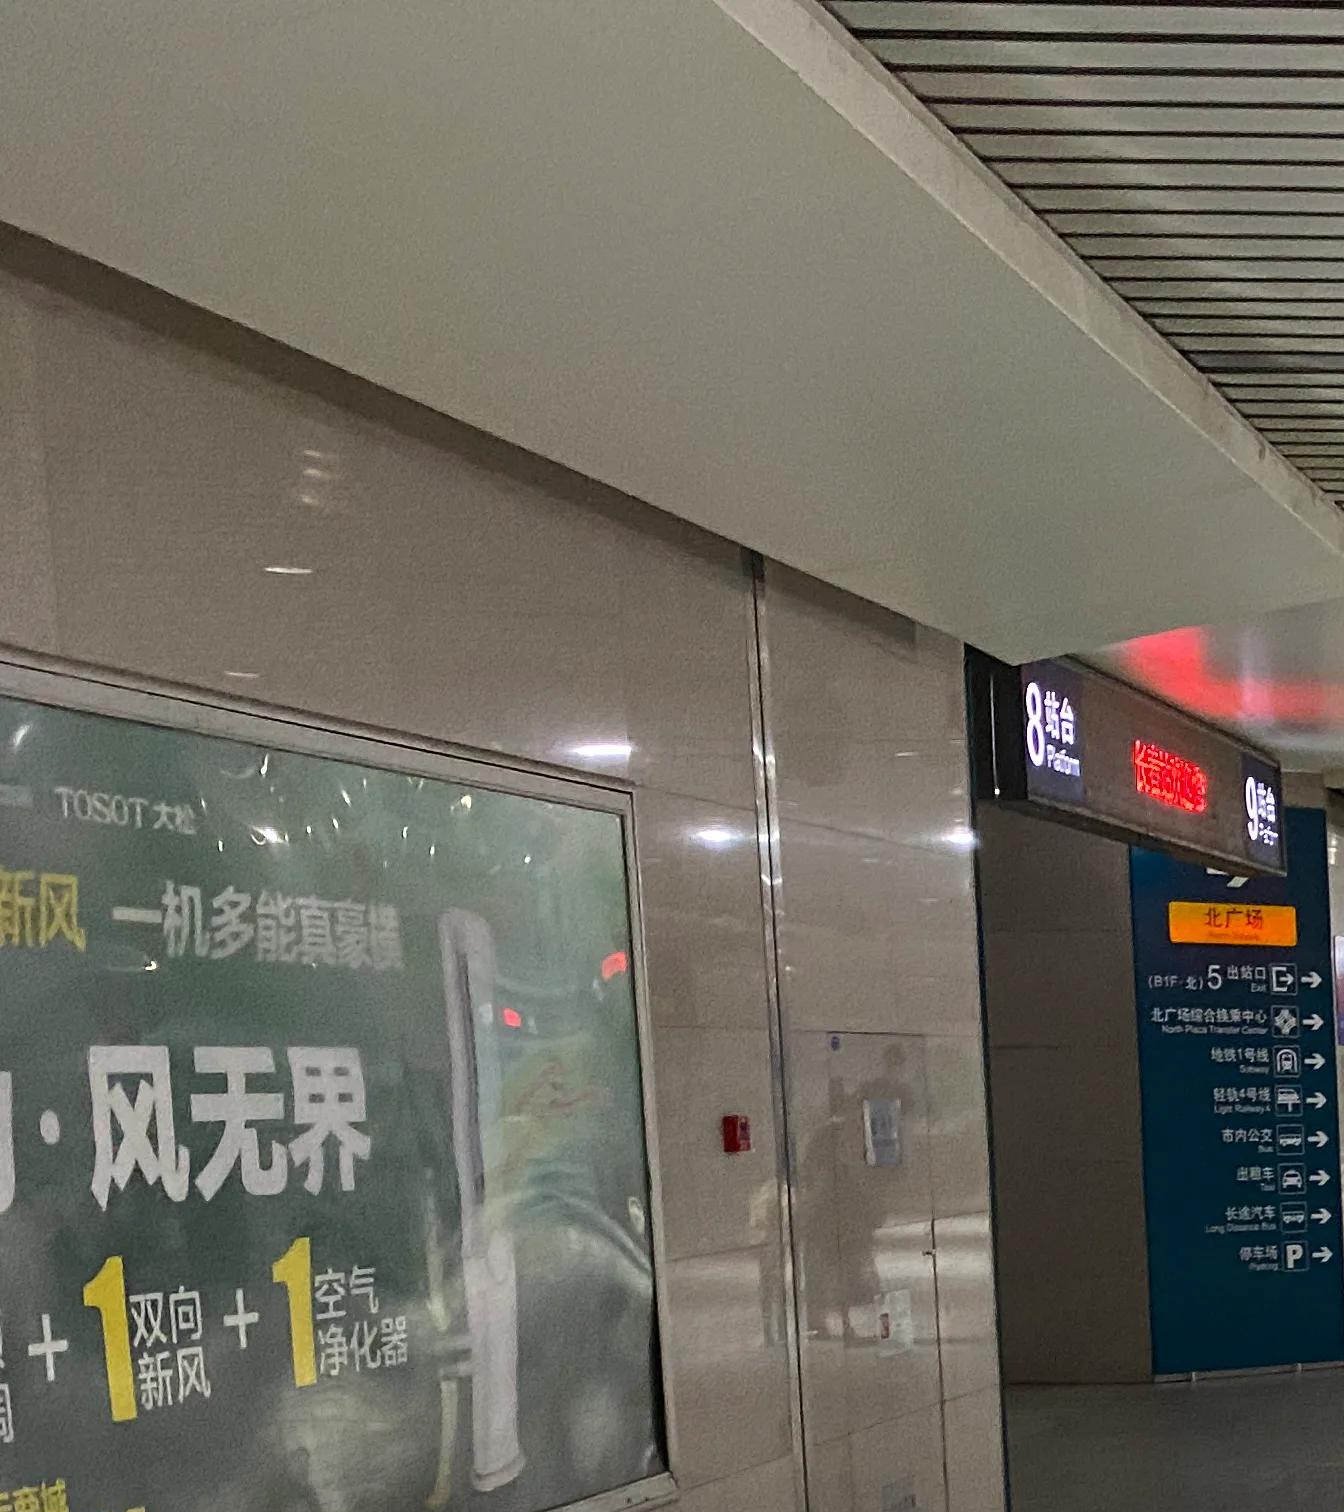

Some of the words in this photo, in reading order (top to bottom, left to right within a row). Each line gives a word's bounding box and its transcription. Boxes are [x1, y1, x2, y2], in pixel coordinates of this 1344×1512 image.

[1026, 682, 1045, 767] 8
[1045, 691, 1075, 746] 站台
[54, 785, 149, 829] TOSOT
[1246, 776, 1259, 841] 9
[1204, 907, 1264, 930] 北广场
[1207, 964, 1222, 990] 5
[1227, 965, 1267, 980] 出站口
[1210, 1046, 1270, 1064] 地铁1号线
[1221, 1128, 1273, 1143] 市内公交
[1236, 1166, 1275, 1182] 出租车
[1225, 1205, 1276, 1221] 长途汽车
[1238, 1245, 1278, 1261] 停车场
[314, 1266, 380, 1320] 空气
[129, 1286, 203, 1347] 双向
[317, 1315, 409, 1377] 净化器
[137, 1346, 211, 1411] 新风
